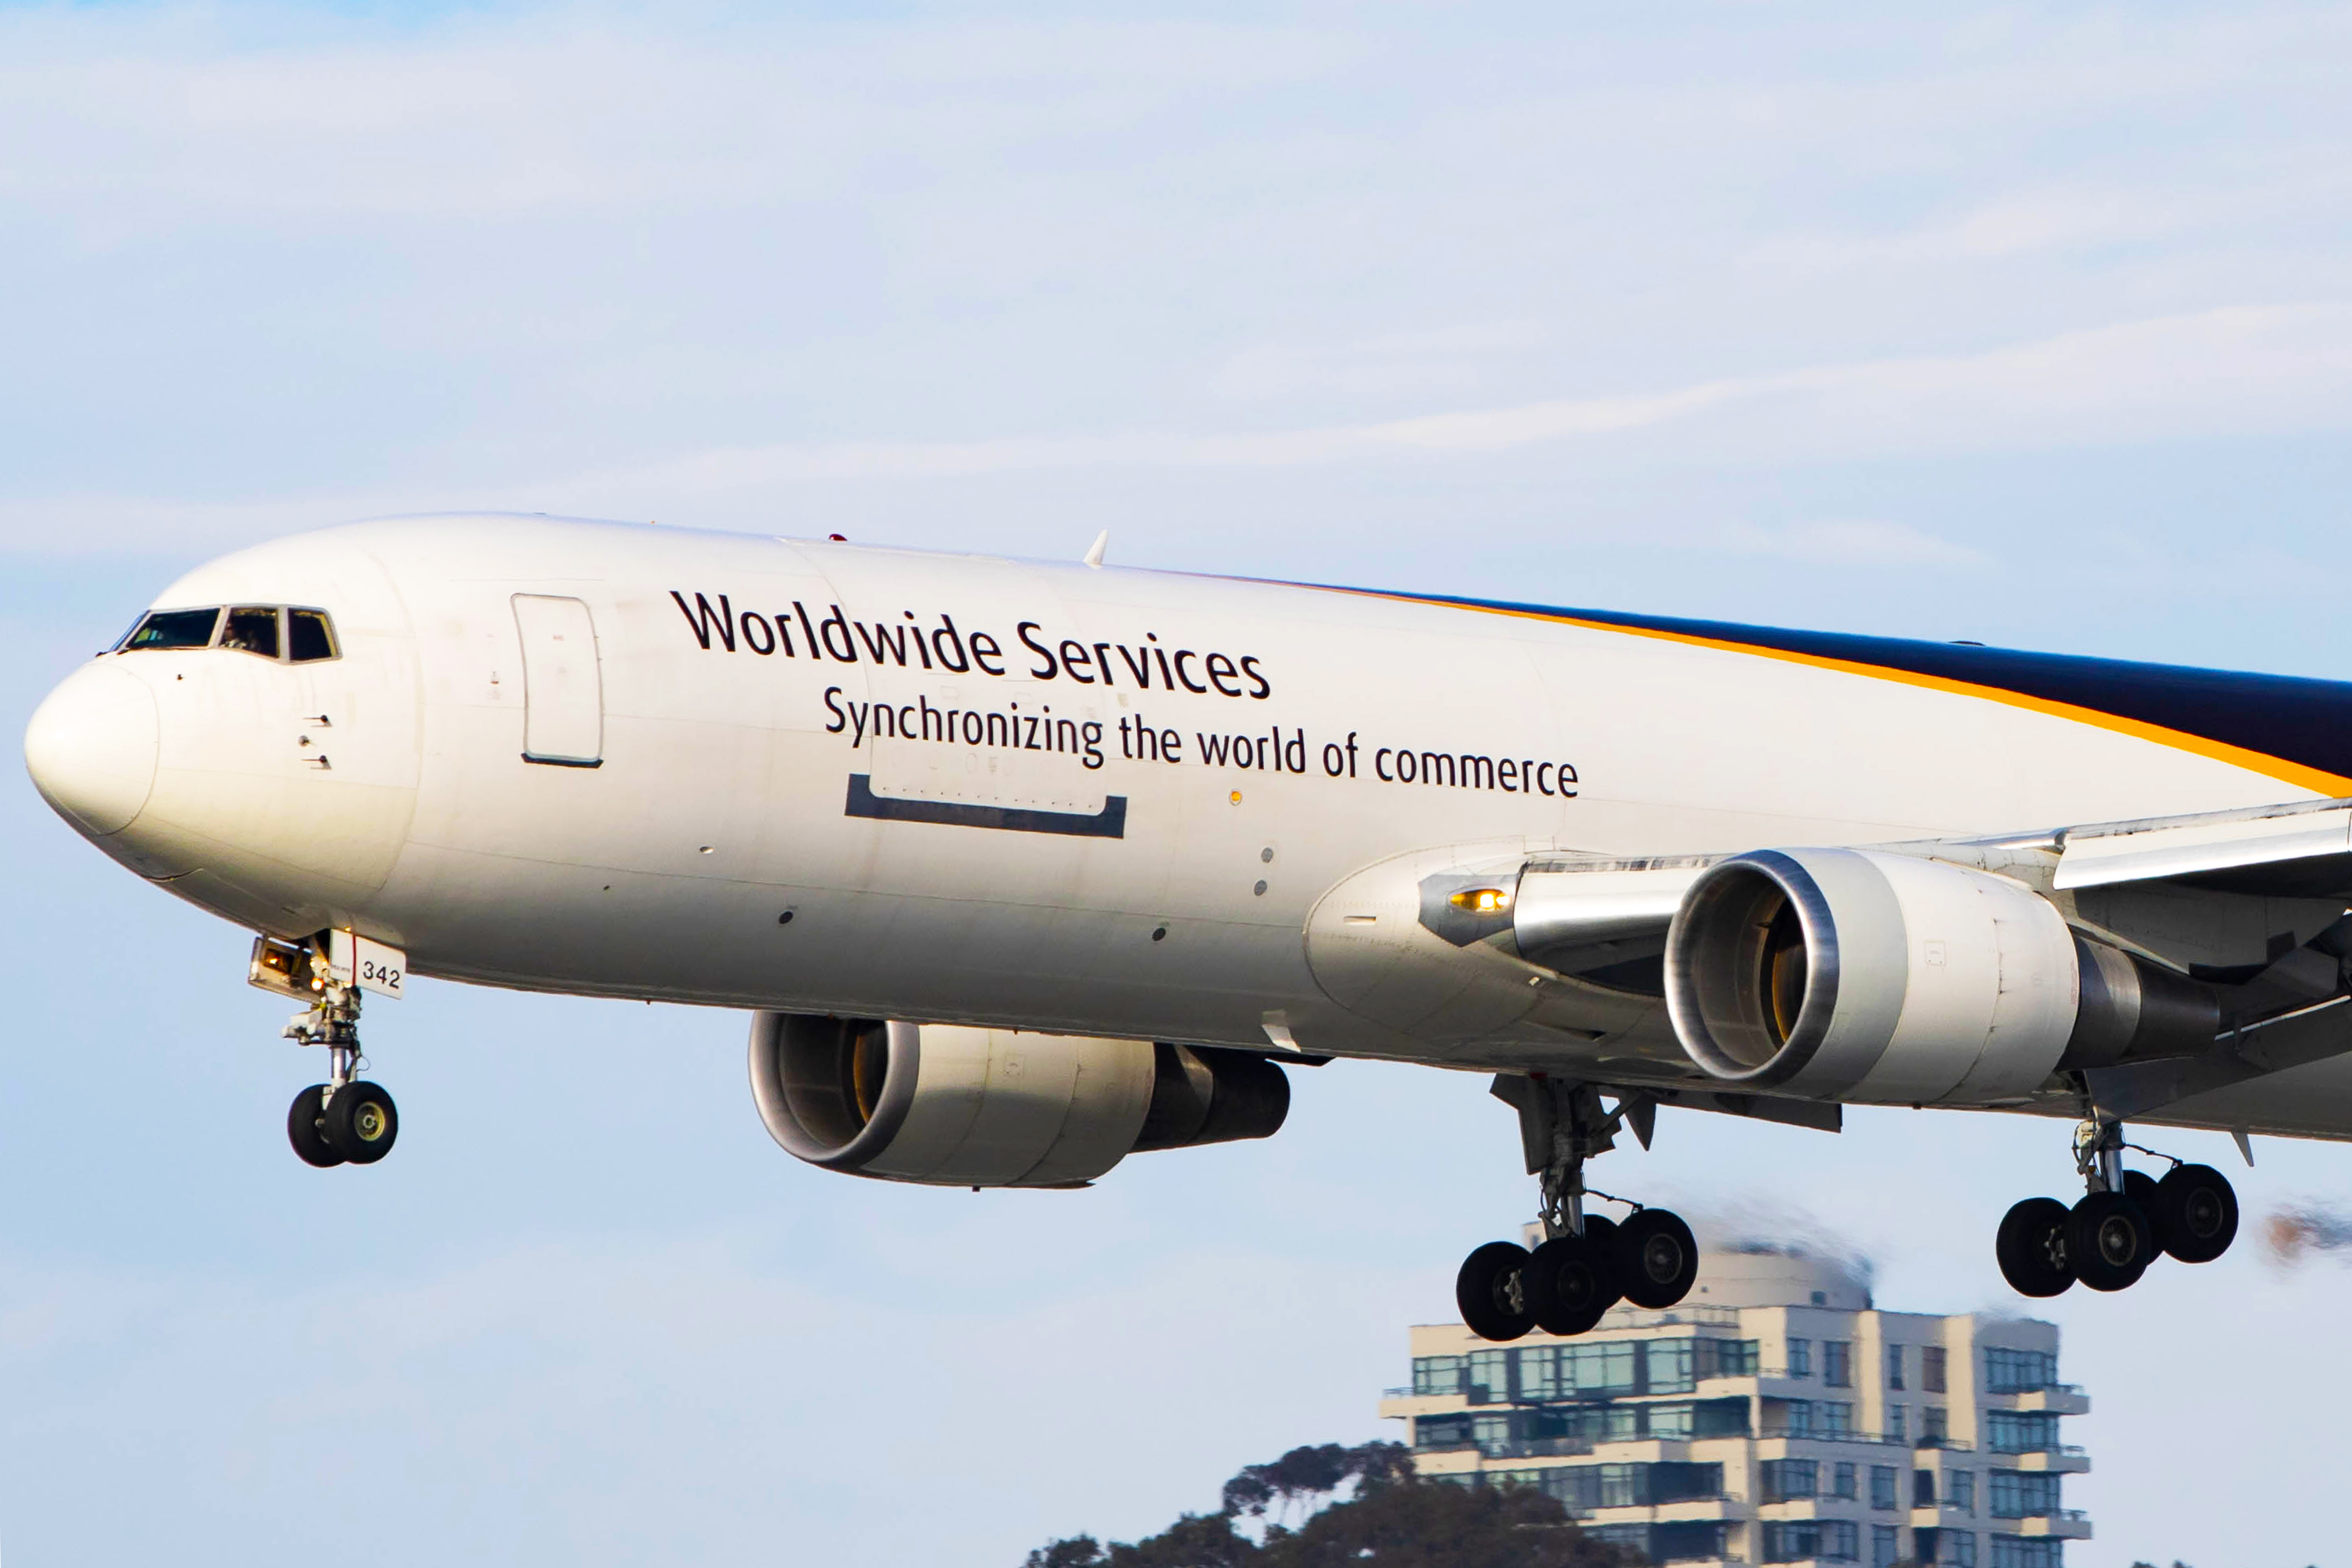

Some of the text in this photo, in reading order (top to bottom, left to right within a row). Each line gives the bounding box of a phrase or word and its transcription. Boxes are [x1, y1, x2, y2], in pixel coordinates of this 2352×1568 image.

[669, 590, 1271, 700] Worldwide Services
[824, 686, 1579, 798] Synchronizing the world of commerce
[363, 960, 400, 989] 342
